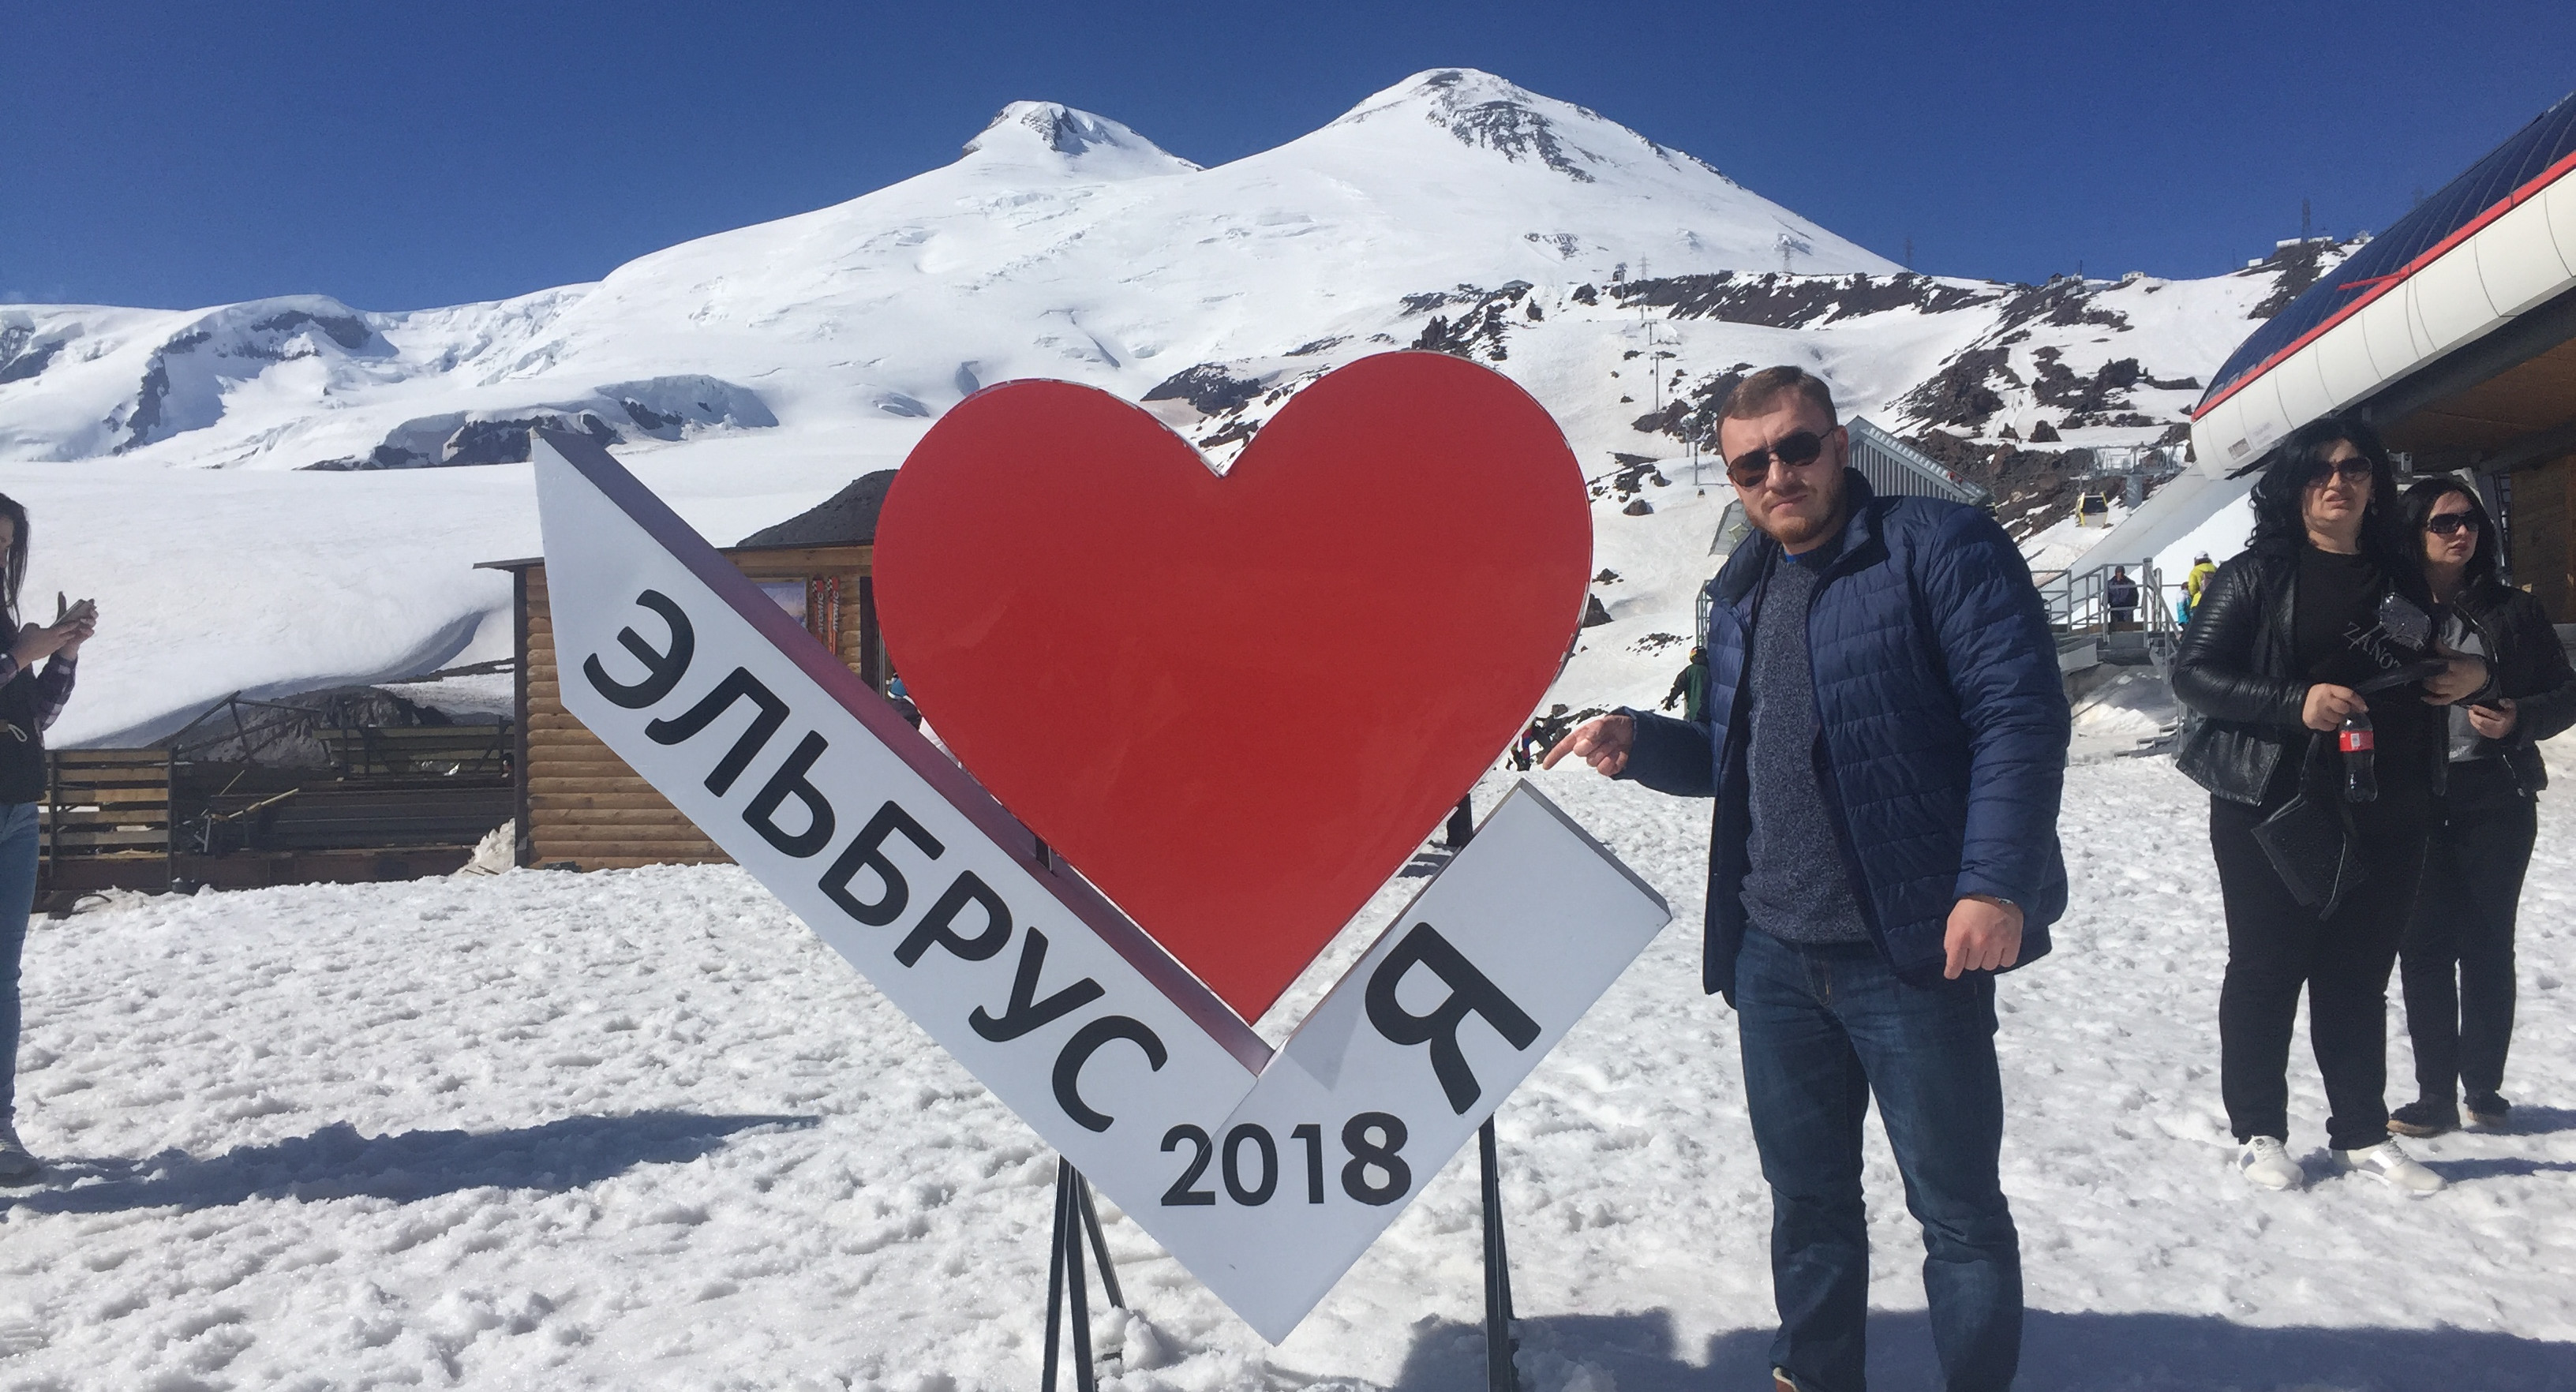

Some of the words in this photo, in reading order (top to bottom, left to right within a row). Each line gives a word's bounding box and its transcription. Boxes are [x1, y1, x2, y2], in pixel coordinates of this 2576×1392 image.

[583, 589, 1168, 1132] ЭЛЬБРУС
[1365, 922, 1541, 1115] Я
[1160, 1112, 1412, 1207] 2018
